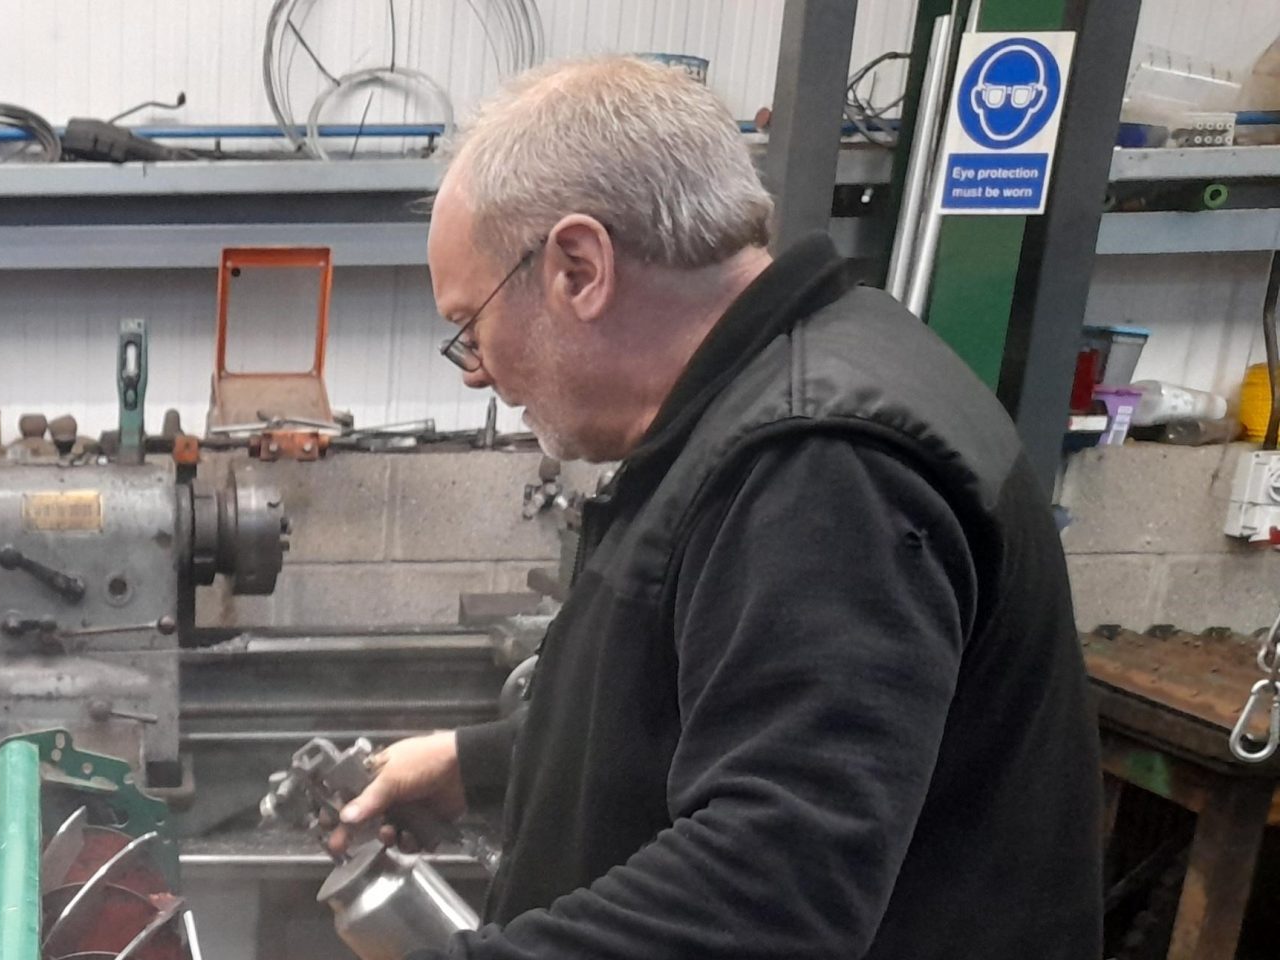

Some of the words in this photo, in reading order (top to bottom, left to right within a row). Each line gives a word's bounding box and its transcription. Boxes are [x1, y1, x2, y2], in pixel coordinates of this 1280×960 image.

[952, 166, 975, 181] Eye
[978, 167, 1039, 181] protection
[952, 186, 982, 197] must
[985, 185, 1000, 197] be
[1002, 187, 1032, 197] worn
